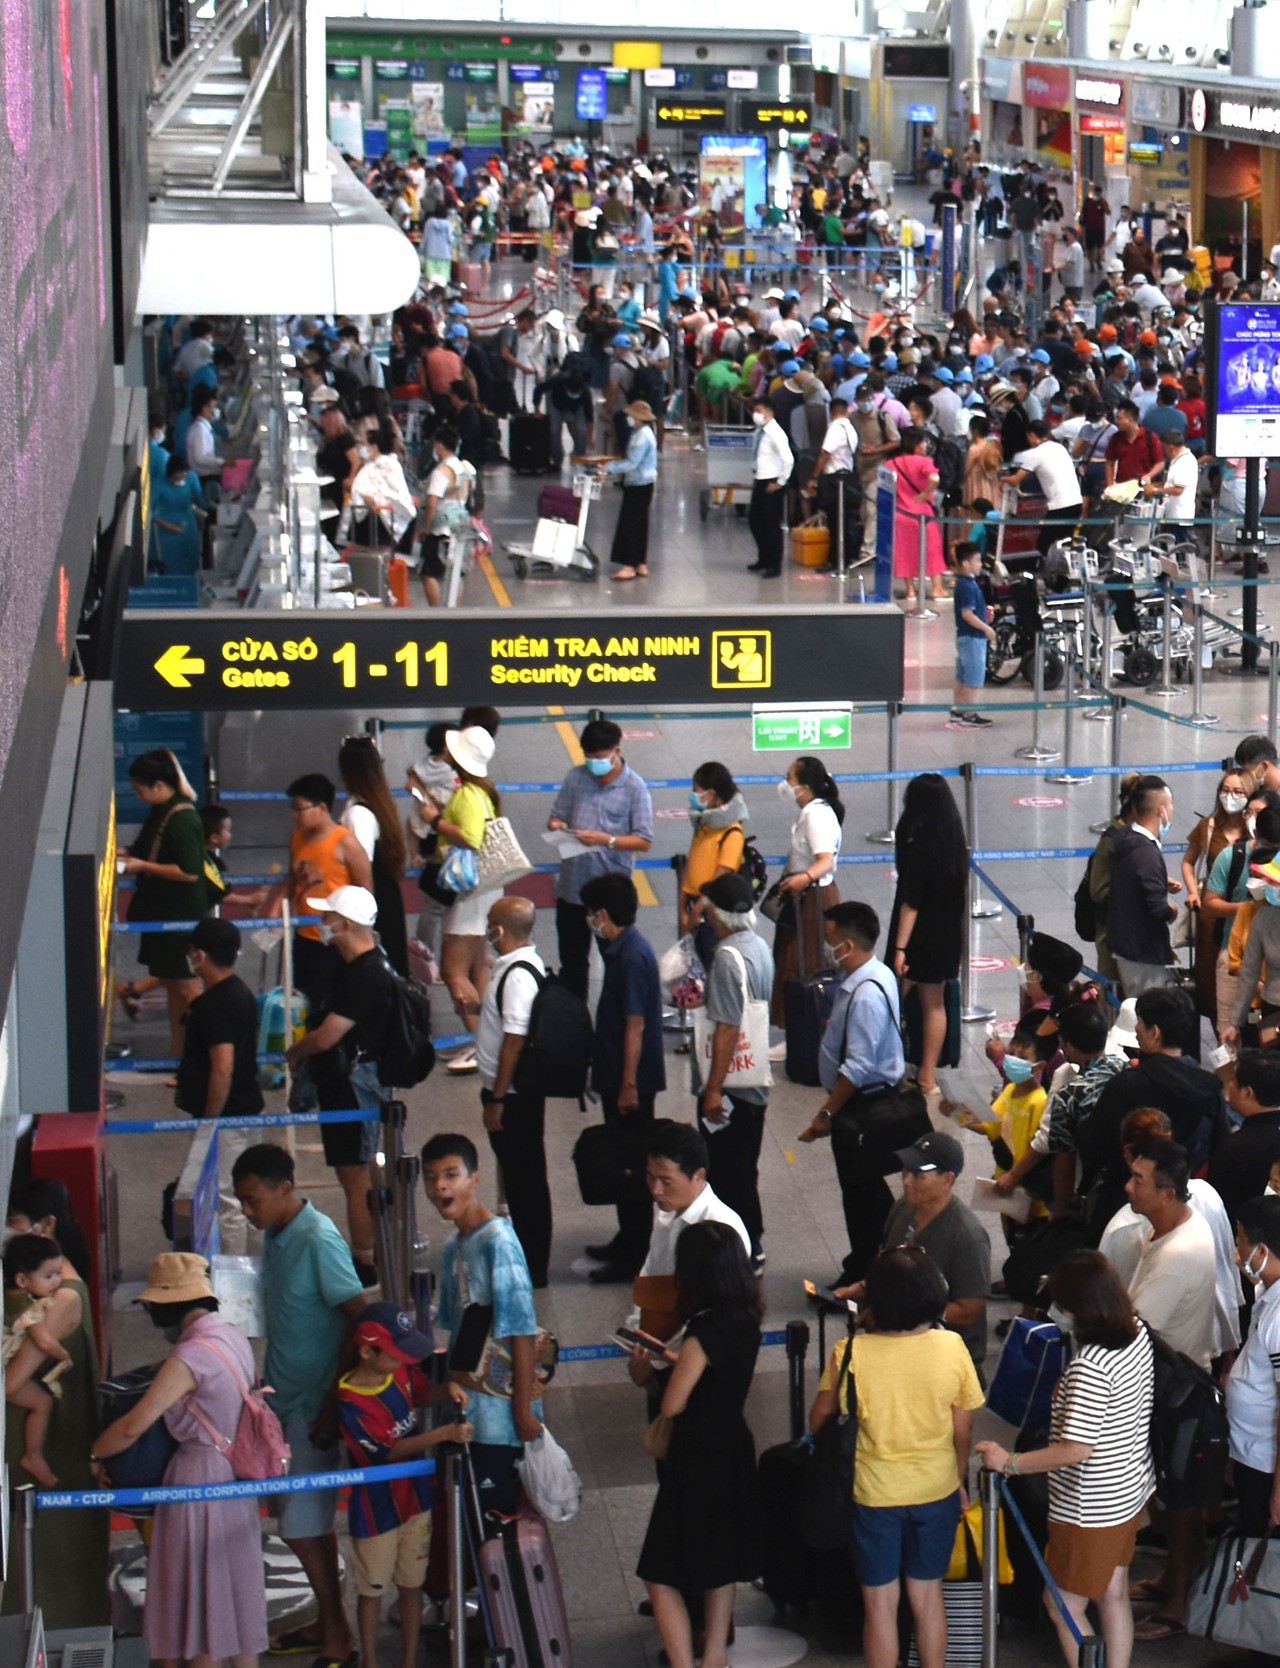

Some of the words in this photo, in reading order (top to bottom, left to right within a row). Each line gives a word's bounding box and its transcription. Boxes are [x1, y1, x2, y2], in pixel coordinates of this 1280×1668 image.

[554, 638, 602, 657] TRA
[604, 637, 639, 656] AN
[644, 636, 700, 656] NINH
[333, 642, 356, 688] 1
[395, 641, 448, 687] 11
[490, 663, 582, 687] Security
[586, 662, 656, 684] Check
[221, 667, 290, 688] Gates
[153, 1118, 198, 1130] AIRPORTS
[265, 1115, 277, 1125] OF
[279, 1113, 319, 1124] VIETNAM
[142, 1488, 202, 1502] AIRPORTS
[204, 1481, 290, 1498] CORPORATION
[292, 1478, 307, 1490] OF
[312, 1472, 365, 1487] VIETNAM
[41, 1494, 72, 1506] NAM
[82, 1493, 116, 1505] CTCP
